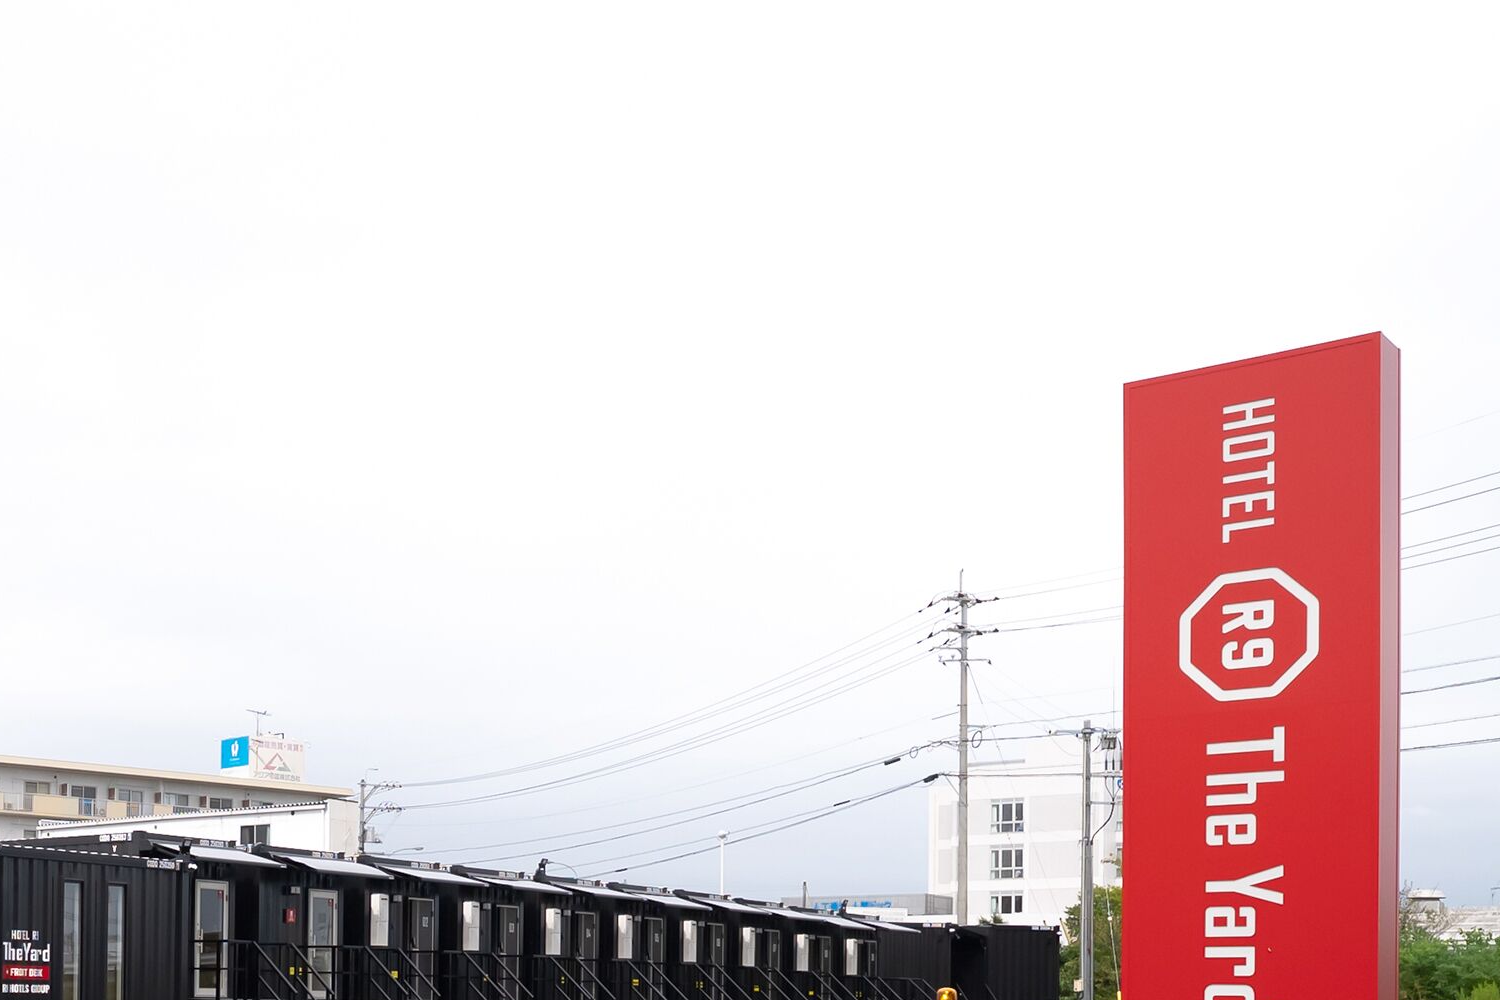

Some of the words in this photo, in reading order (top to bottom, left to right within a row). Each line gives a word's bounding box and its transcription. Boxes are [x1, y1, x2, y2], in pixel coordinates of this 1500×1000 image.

[1222, 397, 1275, 543] HOTEL
[1221, 599, 1275, 670] R9
[1205, 725, 1285, 846] The
[11, 930, 30, 940] HOTEL
